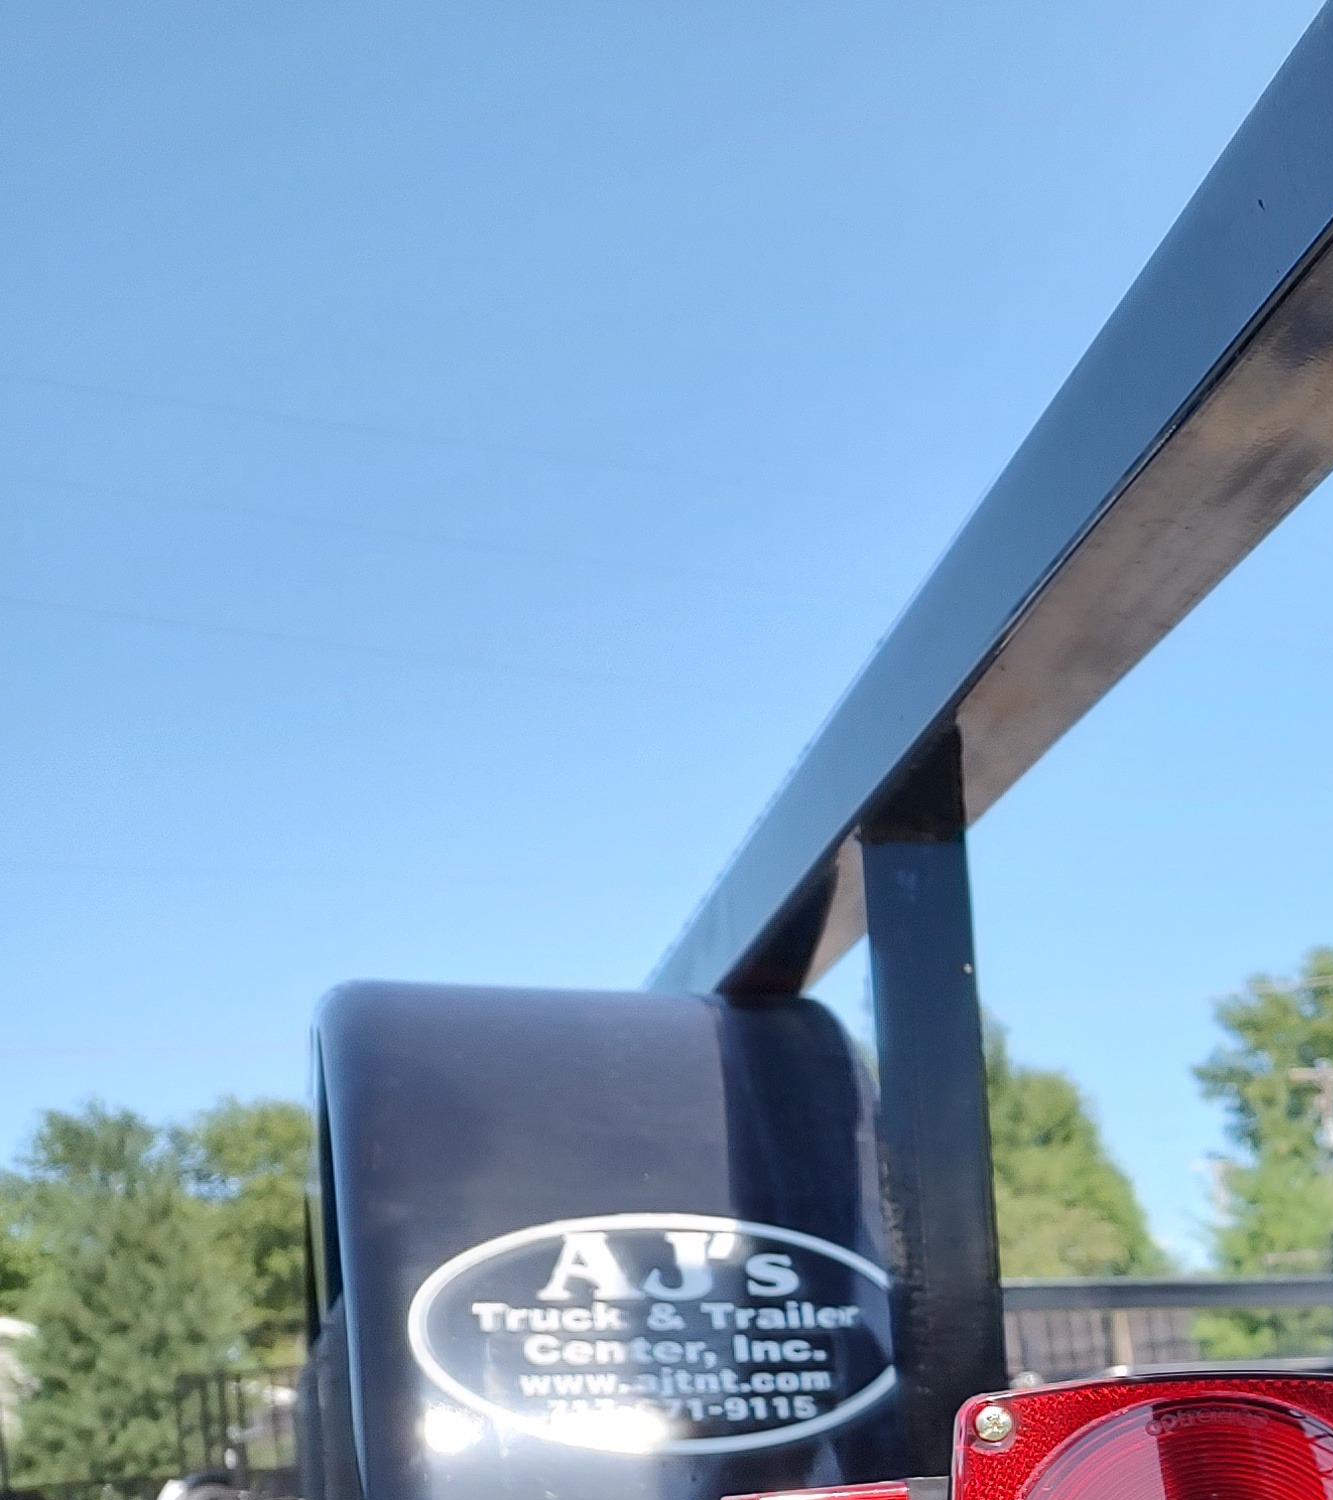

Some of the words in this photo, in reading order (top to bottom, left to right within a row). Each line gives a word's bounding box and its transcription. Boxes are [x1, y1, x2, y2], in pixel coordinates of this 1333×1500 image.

[538, 1230, 799, 1300] AJ's
[472, 1302, 622, 1332] Truck
[646, 1302, 686, 1332] &
[702, 1302, 859, 1332] Trailer
[523, 1334, 717, 1368] Center,
[732, 1334, 827, 1362] Inc.
[518, 1368, 831, 1397] www.ajtnt.com
[545, 1396, 817, 1421] 71-9115
